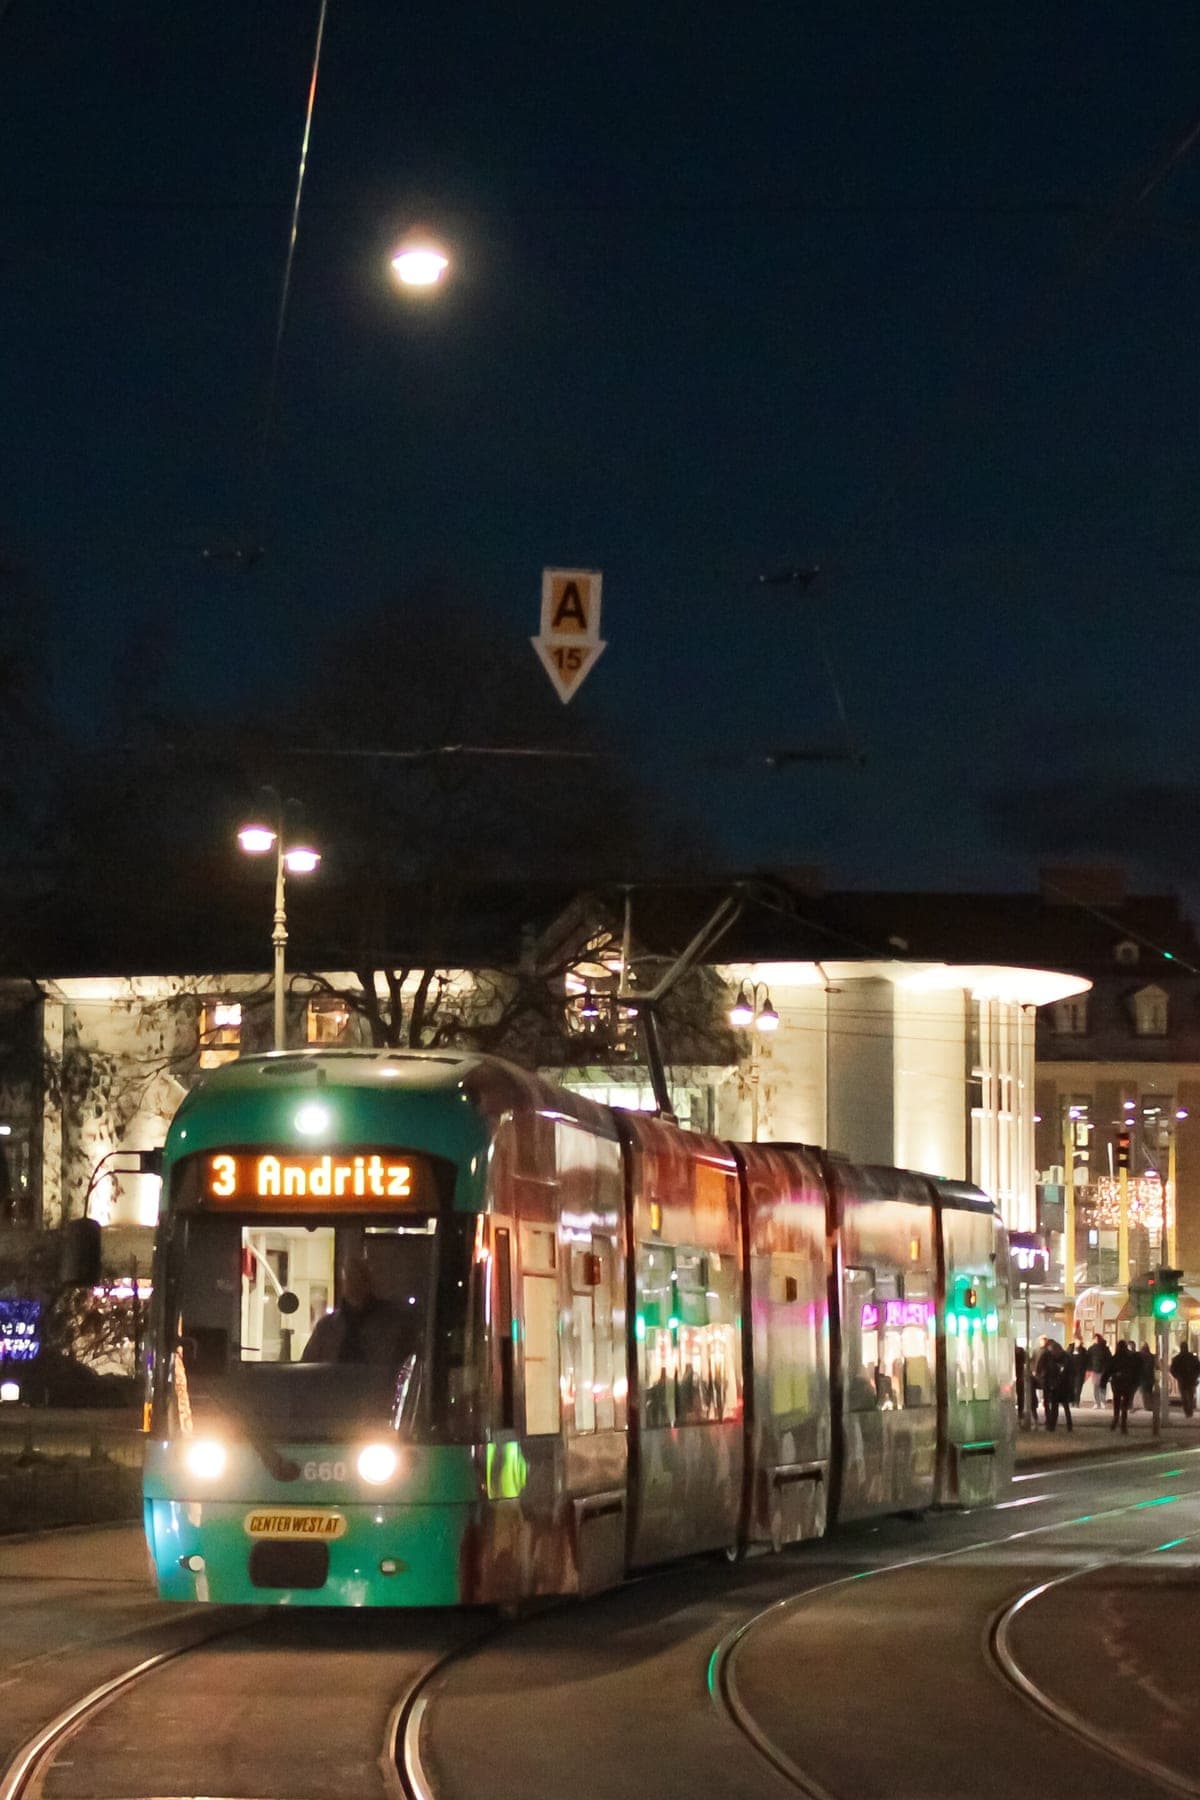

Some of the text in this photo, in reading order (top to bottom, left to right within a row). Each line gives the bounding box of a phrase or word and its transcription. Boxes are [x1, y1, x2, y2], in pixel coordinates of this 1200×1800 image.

[552, 582, 587, 629] A
[554, 648, 582, 670] 15
[212, 1154, 411, 1196] 3 Andritz
[303, 1461, 345, 1481] 660
